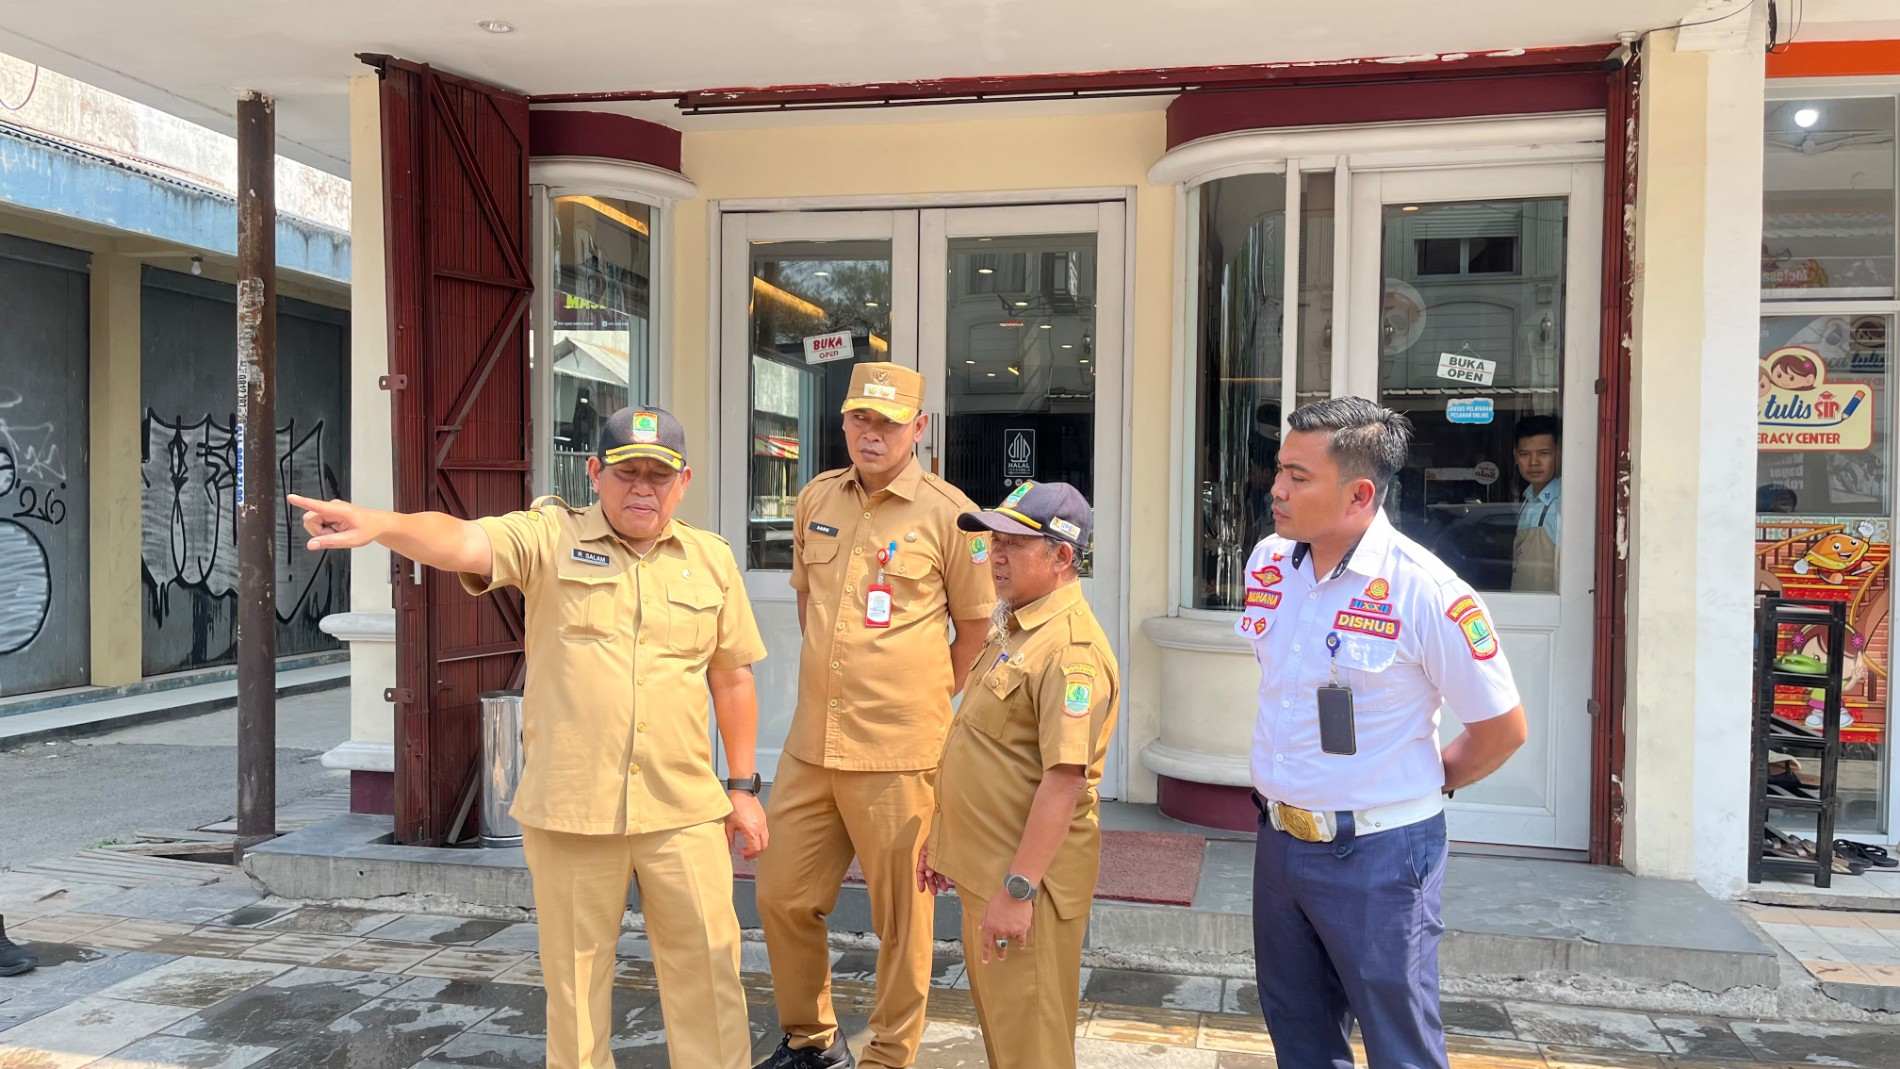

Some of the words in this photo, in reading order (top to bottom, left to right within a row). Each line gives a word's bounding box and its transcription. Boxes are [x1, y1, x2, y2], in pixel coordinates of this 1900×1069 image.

[813, 336, 843, 352] BUKA
[1449, 356, 1484, 371] BUKA
[1448, 368, 1483, 382] OPEN
[1765, 394, 1811, 418] tulis
[1795, 432, 1841, 444] CENTER
[1338, 614, 1395, 635] DISHUB
